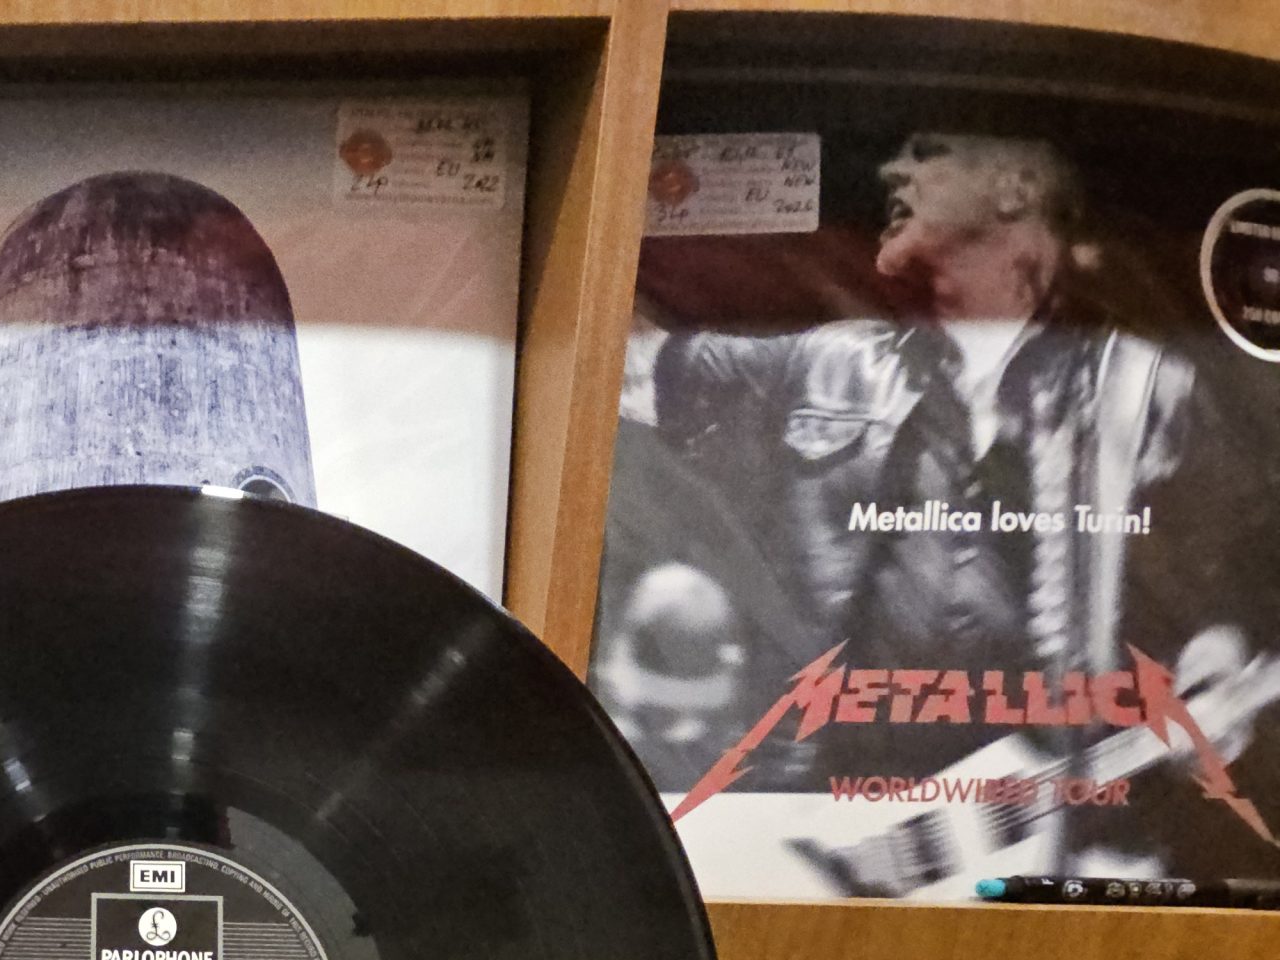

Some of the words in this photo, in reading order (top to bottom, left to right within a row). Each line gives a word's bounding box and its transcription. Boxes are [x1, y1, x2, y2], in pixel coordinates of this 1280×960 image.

[848, 500, 982, 532] Metallica
[991, 500, 1065, 532] loves
[1074, 504, 1151, 535] Turin!
[670, 638, 1280, 848] METALLICA
[1052, 778, 1131, 806] TOUR
[140, 870, 175, 883] EMI
